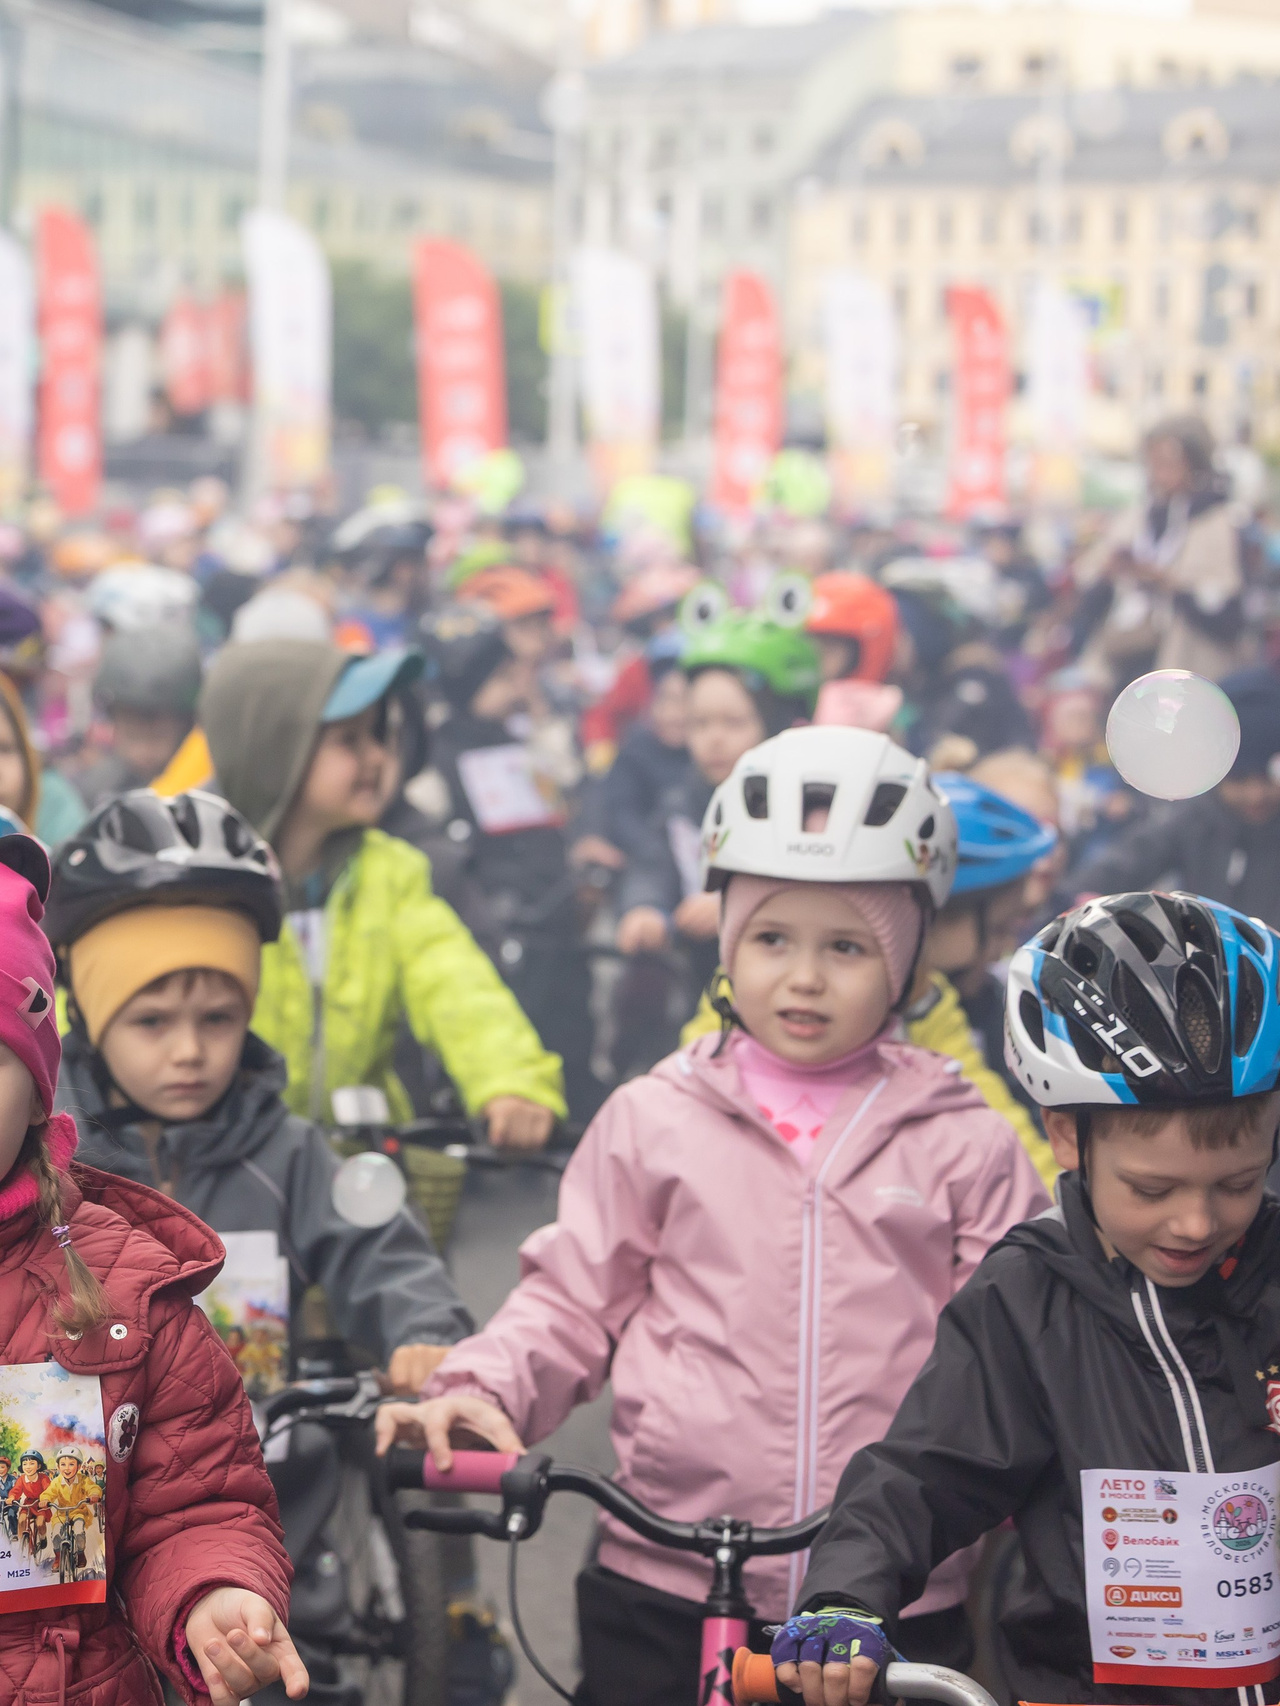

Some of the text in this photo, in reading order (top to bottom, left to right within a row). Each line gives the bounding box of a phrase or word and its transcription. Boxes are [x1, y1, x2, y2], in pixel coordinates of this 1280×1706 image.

[786, 843, 835, 857] HUGO
[1100, 1479, 1145, 1491] ЛЕТО
[1201, 1482, 1275, 1514] МОСКОВСКИЙ
[1123, 1536, 1179, 1546] Велобайк
[1201, 1514, 1276, 1563] ВЕЛОФЕСТИВАЛЬ
[1217, 1572, 1273, 1598] 0583
